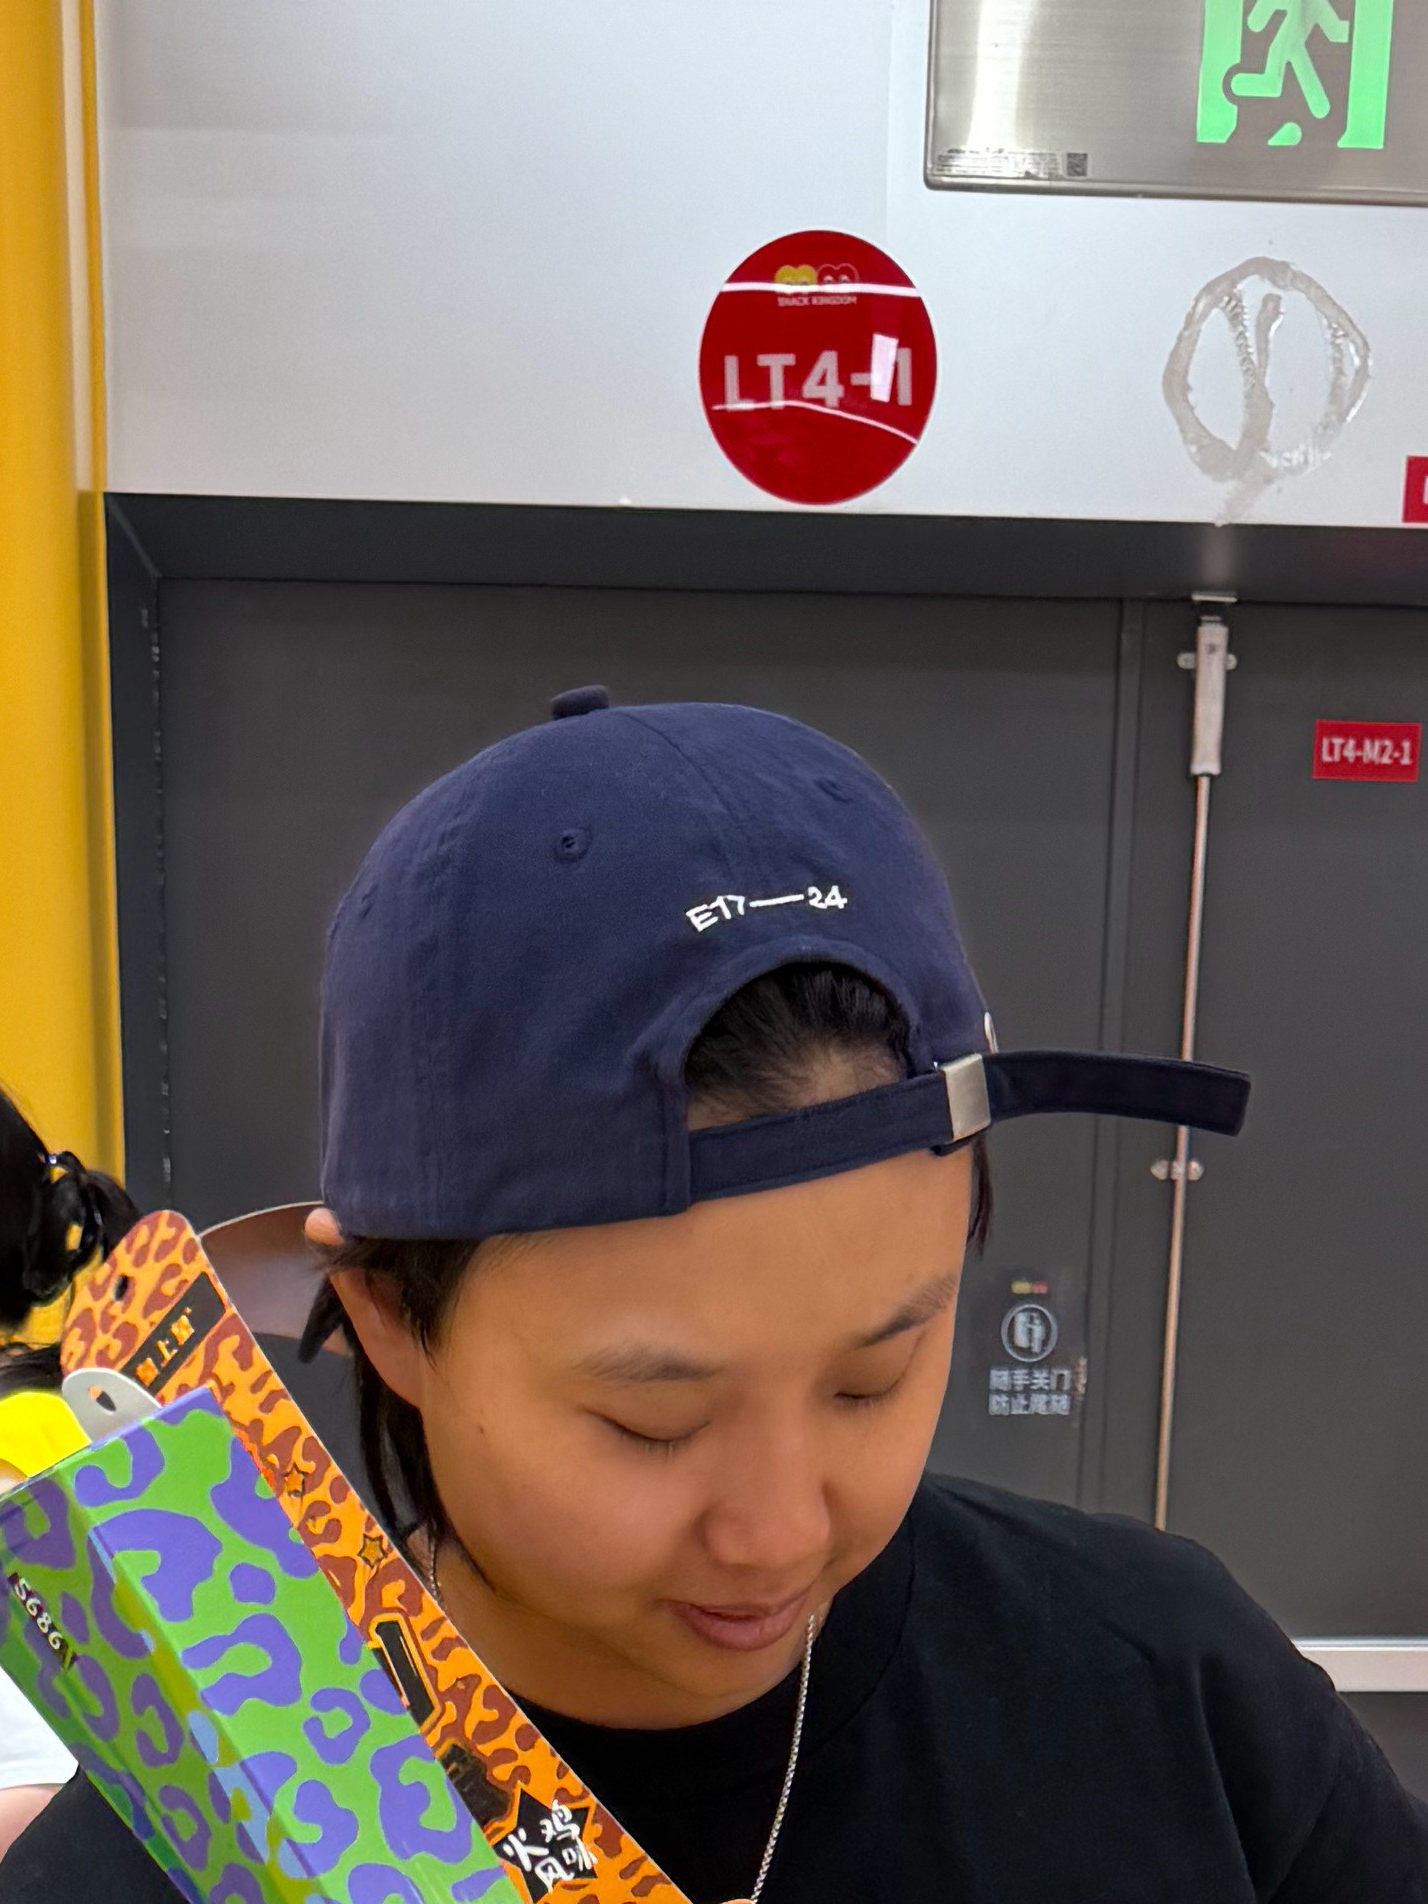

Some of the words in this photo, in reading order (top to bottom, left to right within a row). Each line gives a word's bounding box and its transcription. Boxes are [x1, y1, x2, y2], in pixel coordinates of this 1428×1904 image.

[1320, 735, 1413, 768] LT4-M2-1
[14, 1576, 62, 1651] S686
[503, 1800, 581, 1870] 火鸡
[535, 1840, 598, 1894] 风味
